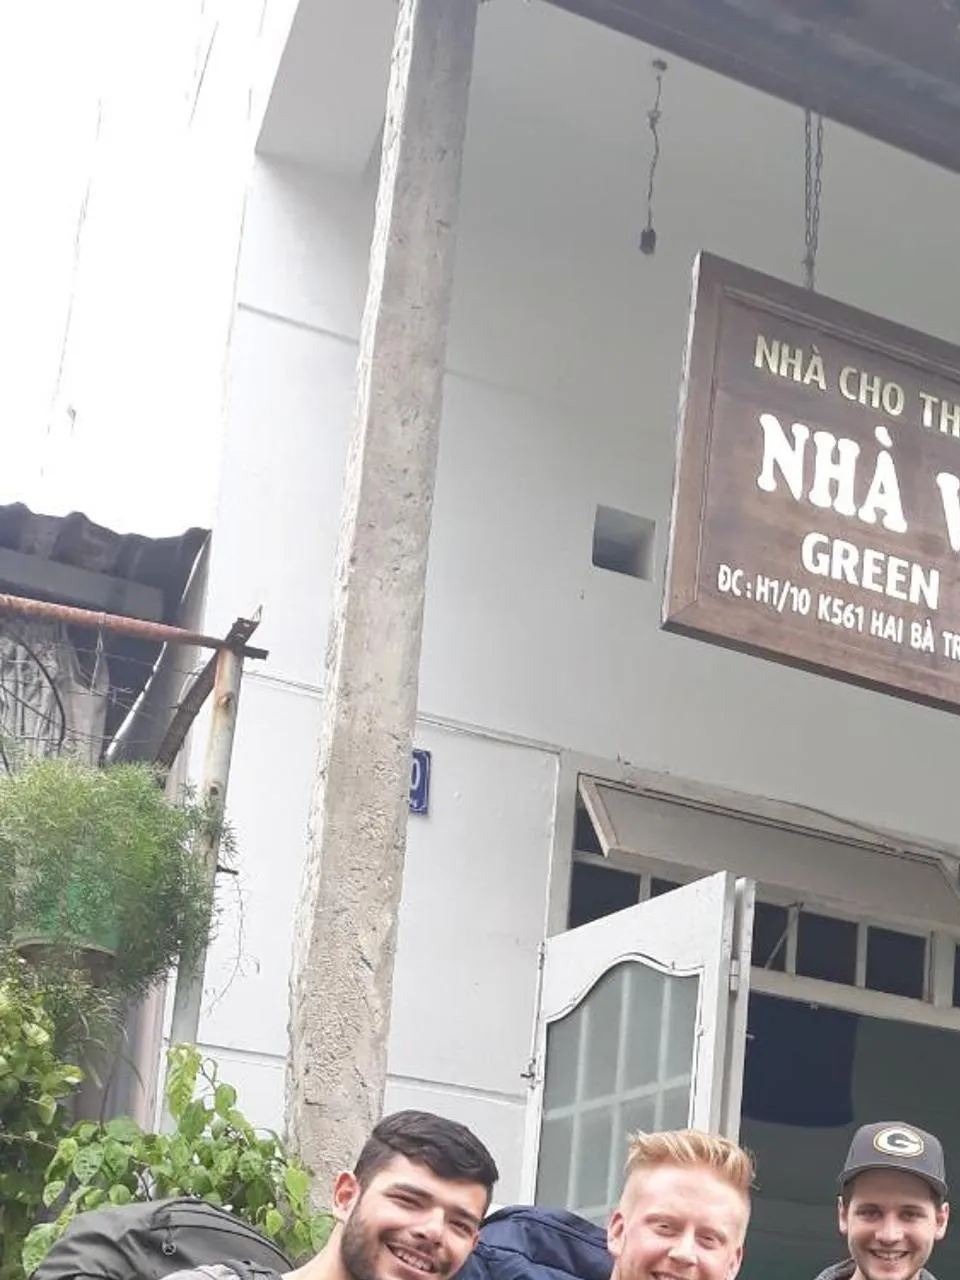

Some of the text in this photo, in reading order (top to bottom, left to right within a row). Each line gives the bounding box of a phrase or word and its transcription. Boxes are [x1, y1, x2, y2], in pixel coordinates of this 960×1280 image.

[754, 334, 827, 391] NHÀ
[839, 366, 905, 416] CHO
[756, 413, 908, 533] NHÀ
[801, 531, 940, 611] GREEN
[817, 593, 864, 632] K561
[870, 609, 904, 644] HAI
[875, 1127, 923, 1157] G
